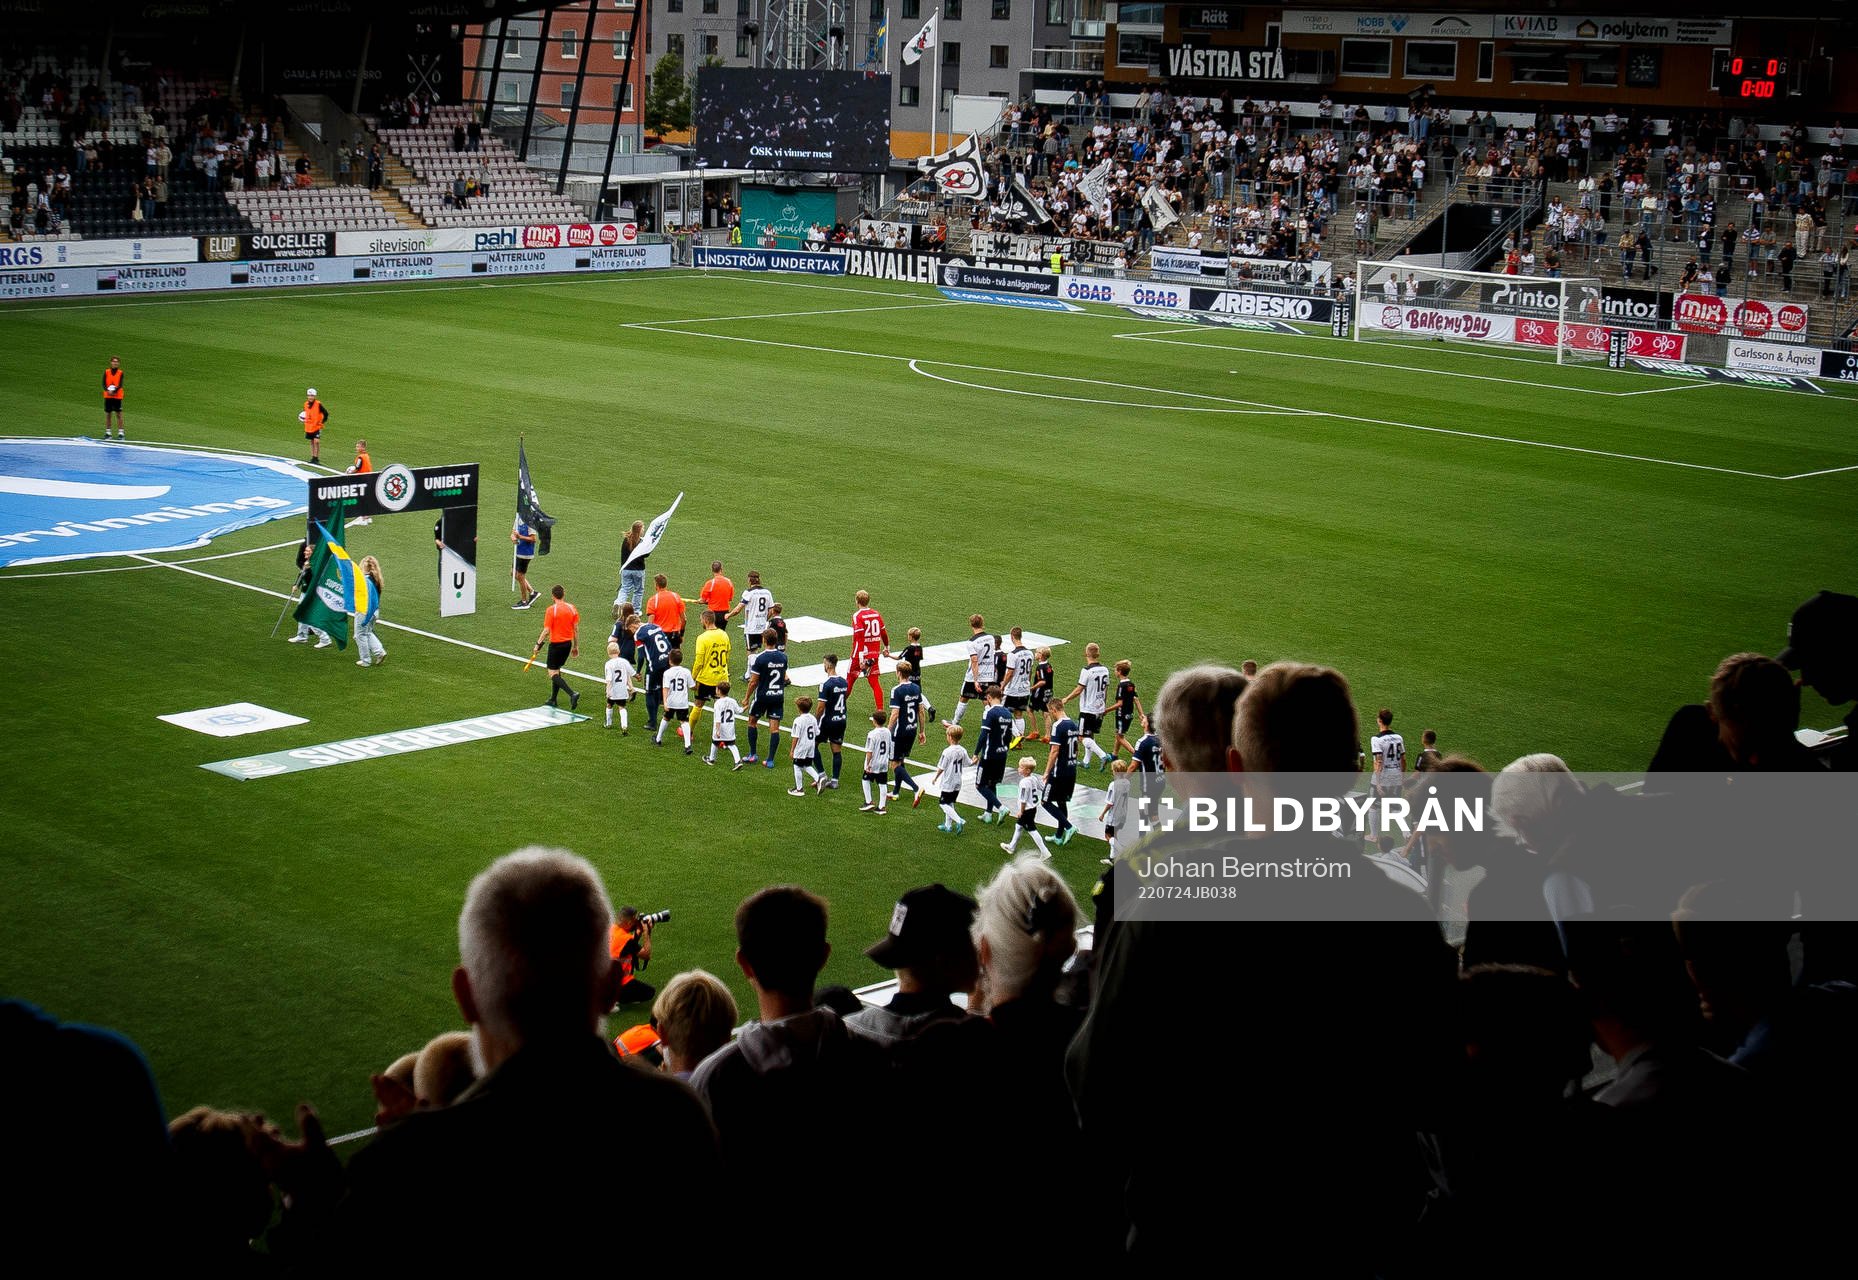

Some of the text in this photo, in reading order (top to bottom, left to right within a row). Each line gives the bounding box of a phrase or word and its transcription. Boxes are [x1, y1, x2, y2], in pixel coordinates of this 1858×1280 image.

[1201, 9, 1229, 24] Rätt
[1504, 16, 1558, 31] KVIAB
[1601, 20, 1669, 39] polyterm
[1168, 44, 1285, 79] VÄSTRA STÅ
[1721, 58, 1787, 76] H 0 0 G
[1741, 80, 1775, 97] 0:00
[750, 145, 833, 159] ÖSK vi vinner mest
[475, 228, 517, 250] pahl
[526, 225, 557, 242] mix
[569, 227, 592, 240] mix
[600, 228, 616, 238] mix
[209, 237, 236, 253] ELOP
[252, 234, 326, 250] SOLCELLER
[369, 238, 425, 253] sitevision
[371, 256, 433, 268] NÄTTERLUND
[489, 251, 546, 262] NÄTTERLUND
[591, 248, 647, 259] NÄTTERLUND
[697, 252, 840, 271] LINDSTRÖM UNDERTAK
[117, 267, 187, 280] NÄTTERLUND
[250, 262, 315, 274] NÄTTERLUND
[963, 275, 974, 283] En
[975, 275, 991, 284] klubb
[995, 277, 1006, 286] två
[1006, 277, 1051, 291] anläggningar
[1067, 278, 1112, 302] ÖBAB
[1133, 284, 1178, 308] ÖBAB
[1209, 292, 1312, 320] ARBESKO
[1679, 299, 1721, 322] mix
[1333, 305, 1341, 336] SELECT
[1341, 304, 1349, 336] SELECT
[1738, 307, 1769, 325] mix
[1781, 310, 1803, 323] mix
[1608, 336, 1618, 367] SELECT
[1619, 336, 1628, 367] SELECT
[1734, 347, 1816, 366] Carlsson & Åqvist
[1839, 369, 1858, 380] SA
[424, 474, 470, 490] UNIBET
[317, 483, 368, 500] UNIBET
[453, 571, 465, 590] U
[758, 596, 766, 612] 8
[863, 619, 881, 637] 20
[654, 633, 668, 653] 6
[982, 643, 991, 660] 2
[709, 650, 728, 669] 30
[1019, 658, 1032, 676] 30
[615, 669, 623, 683] 2
[669, 677, 685, 691] 13
[768, 669, 781, 689] 2
[1094, 674, 1108, 692] 16
[834, 693, 845, 714] 4
[906, 701, 916, 723] 5
[720, 708, 734, 723] 12
[287, 705, 558, 765] SUPERETTAN
[806, 727, 814, 741] 6
[879, 740, 887, 755] 9
[1067, 737, 1078, 759] 10
[953, 758, 963, 773] 11
[1031, 789, 1038, 804] 5
